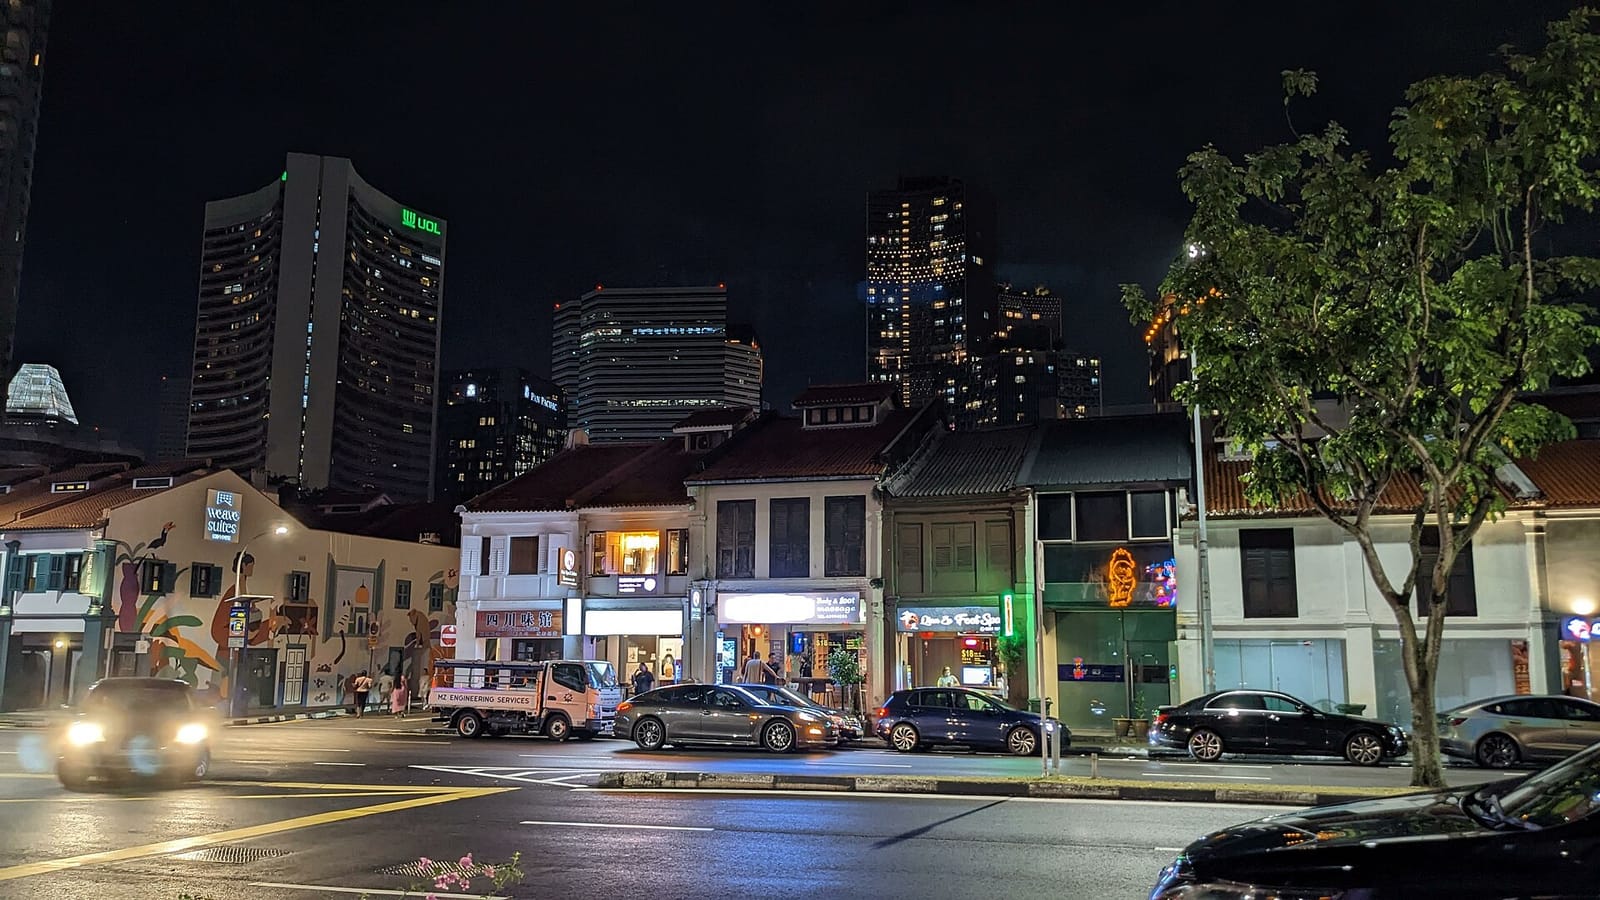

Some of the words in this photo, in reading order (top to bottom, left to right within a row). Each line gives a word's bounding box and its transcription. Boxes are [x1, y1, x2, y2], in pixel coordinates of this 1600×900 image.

[417, 217, 441, 235] UOL
[207, 519, 237, 534] suites
[954, 613, 981, 627] Foot
[450, 694, 495, 703] ENGINEERING
[497, 696, 530, 704] SERVICES
